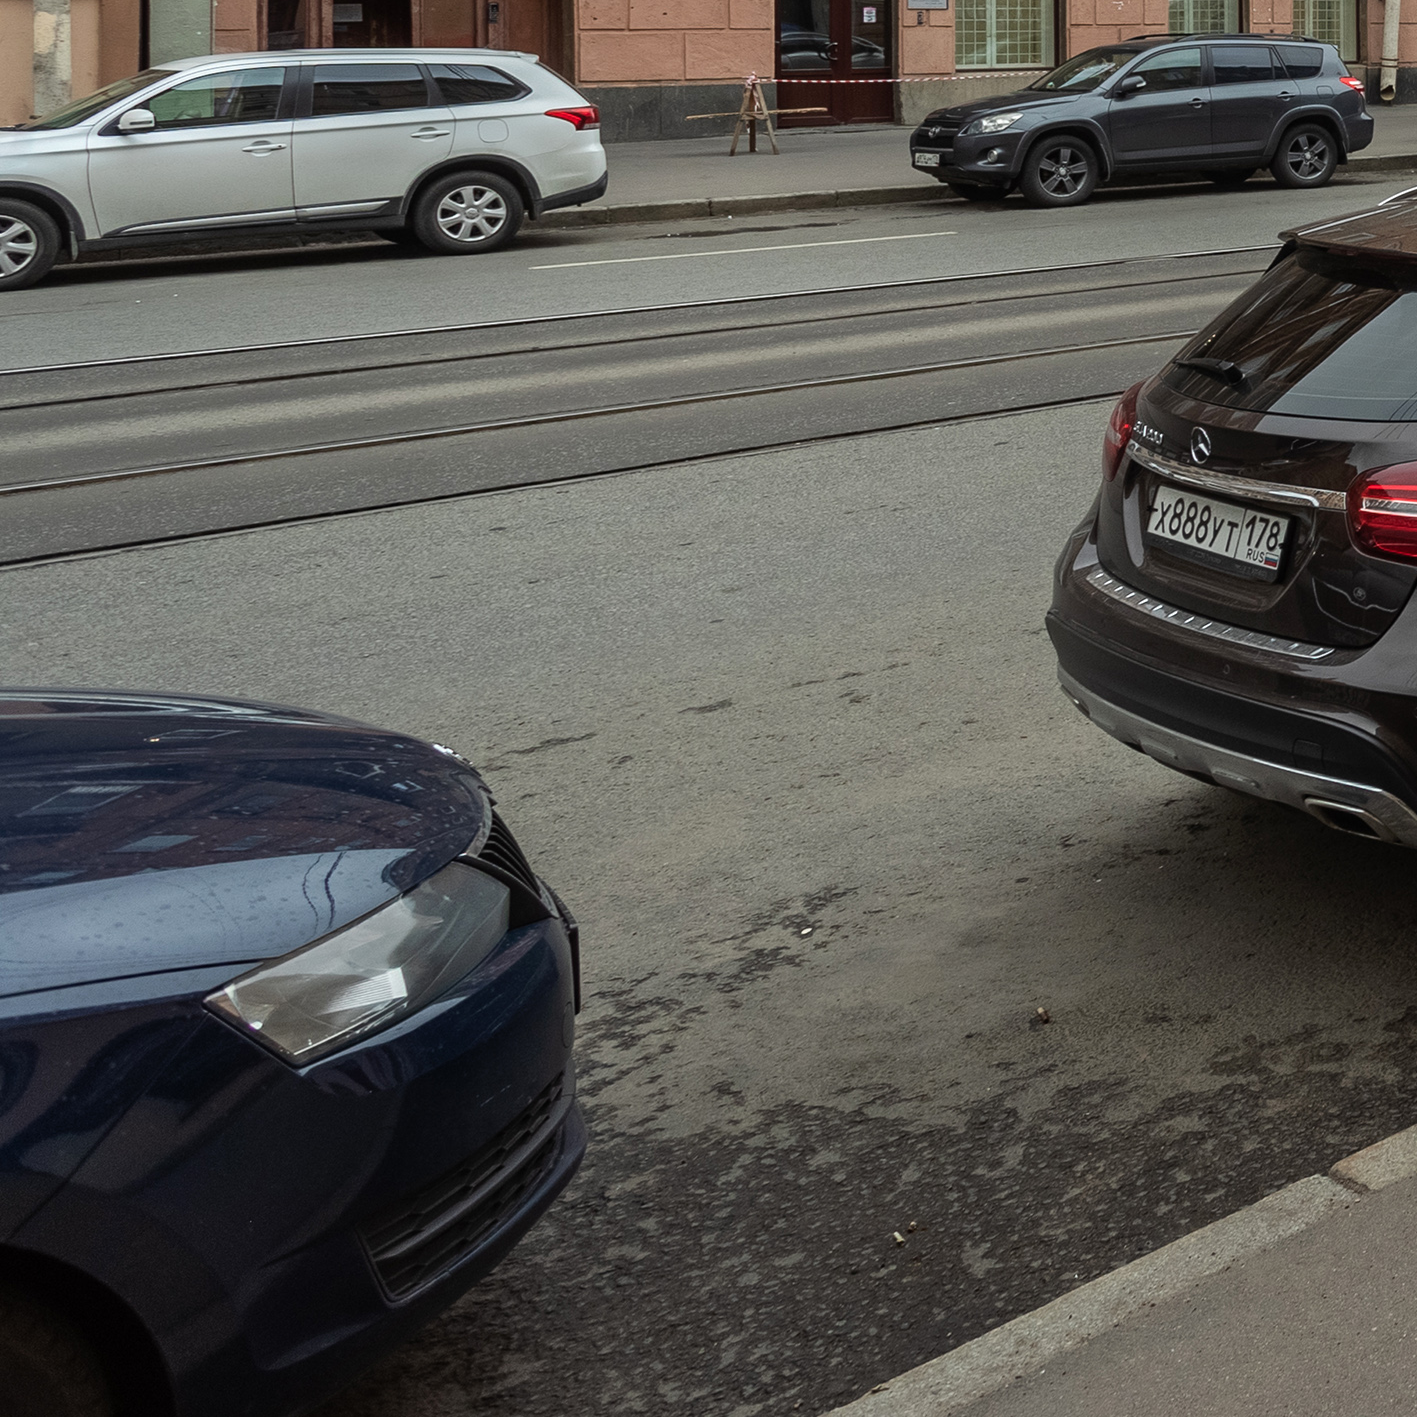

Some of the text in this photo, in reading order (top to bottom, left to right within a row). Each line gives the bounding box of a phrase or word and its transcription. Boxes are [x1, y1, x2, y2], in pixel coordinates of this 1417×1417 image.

[1154, 497, 1281, 553] Х888УТ 178
[1246, 548, 1265, 564] RUS
